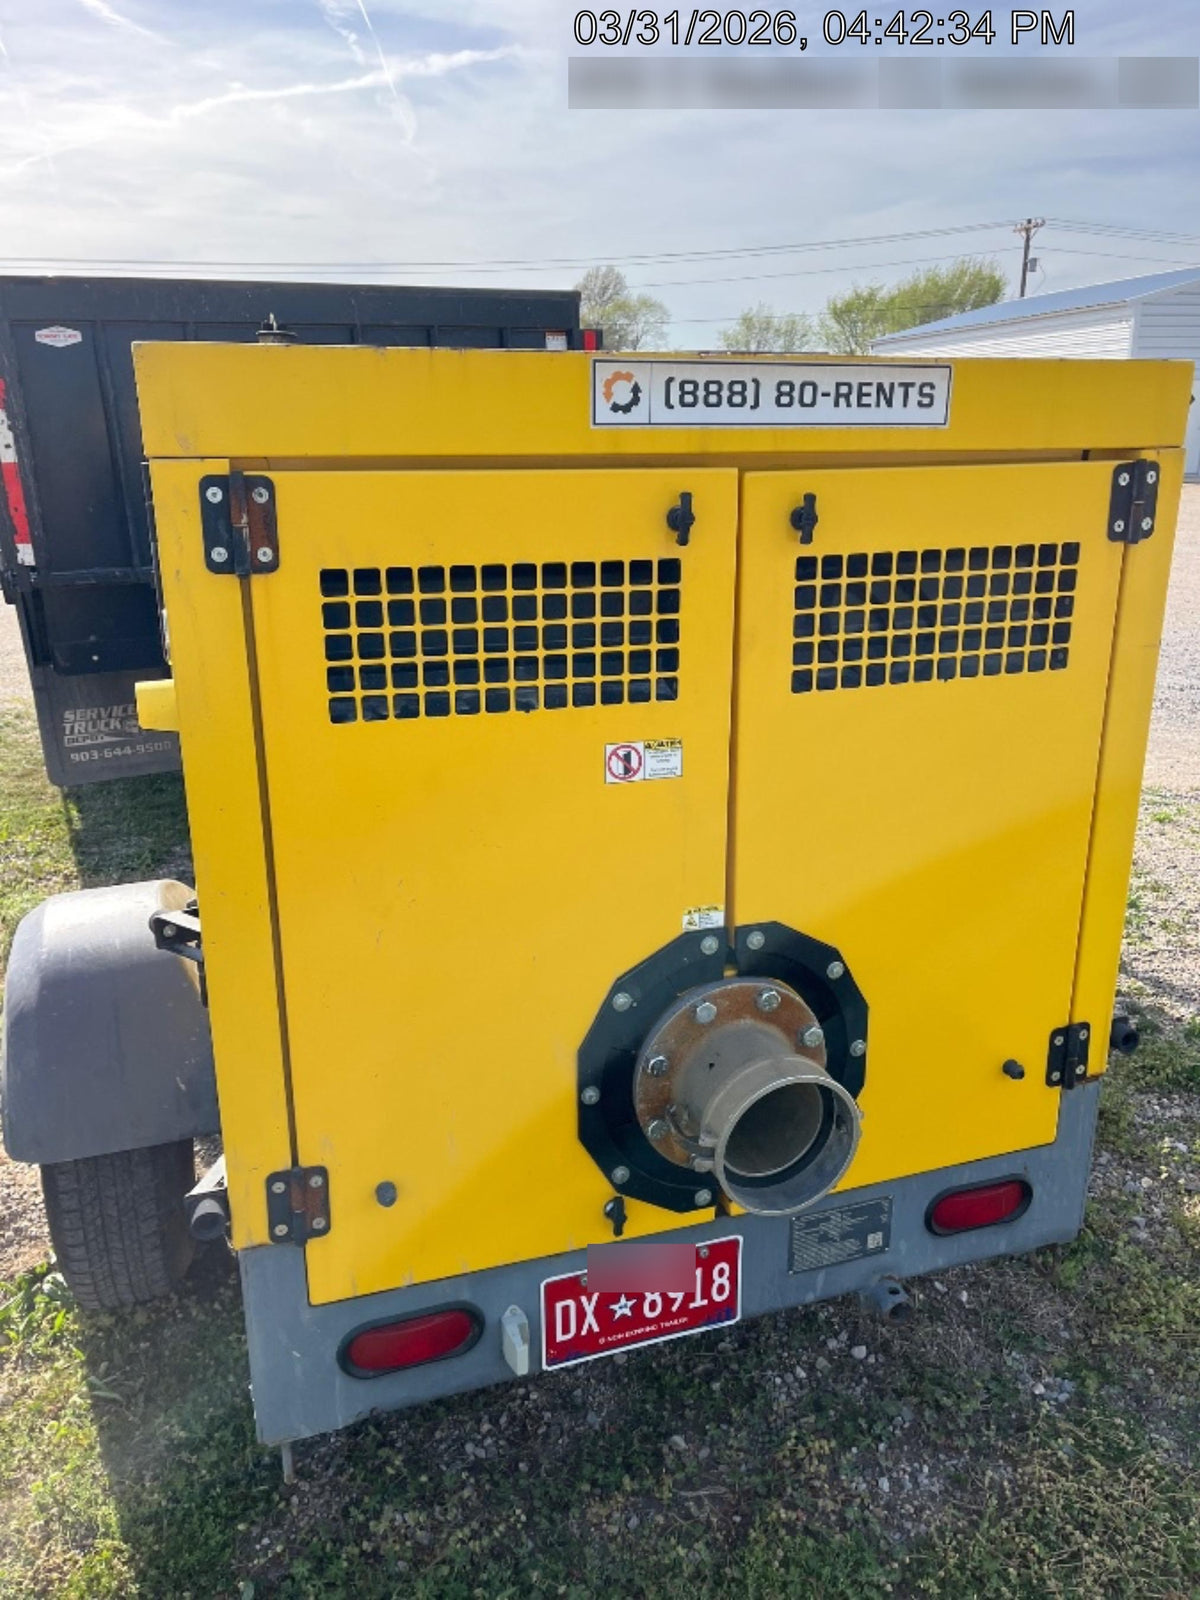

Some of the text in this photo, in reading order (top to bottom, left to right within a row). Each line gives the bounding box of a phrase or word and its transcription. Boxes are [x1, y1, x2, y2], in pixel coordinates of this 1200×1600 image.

[664, 376, 937, 410] (888) 80-RENTS
[63, 718, 122, 735] TRUCK
[556, 1291, 600, 1343] DX
